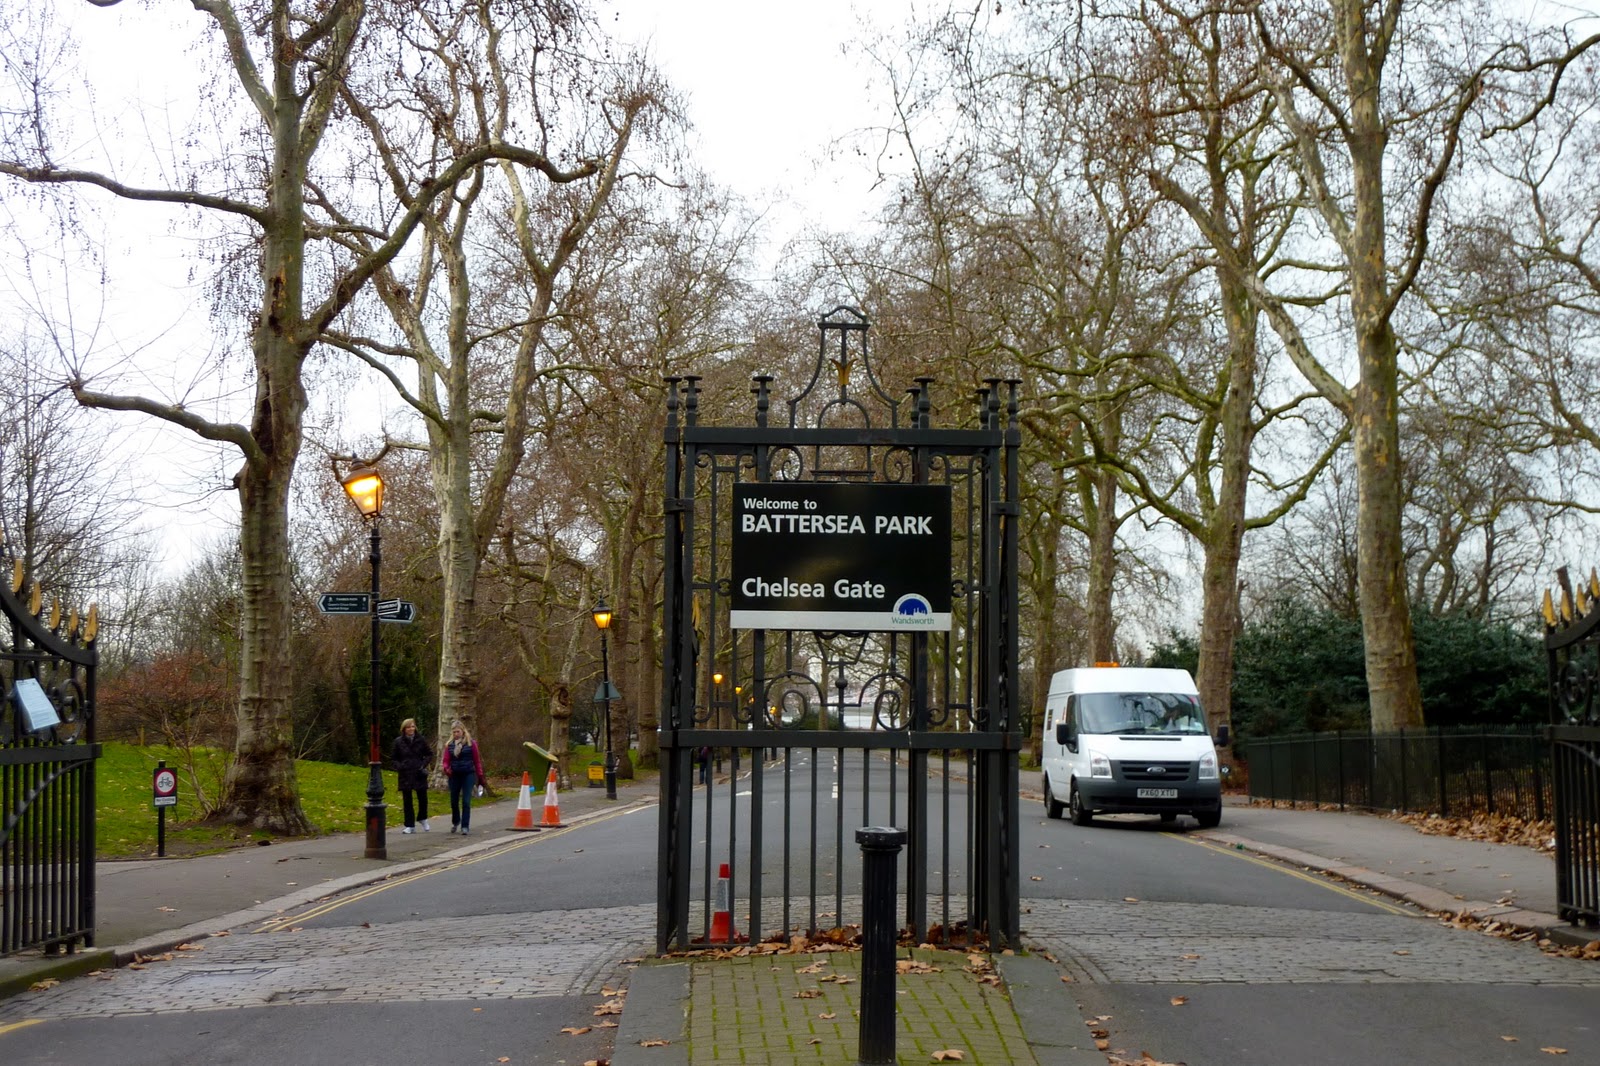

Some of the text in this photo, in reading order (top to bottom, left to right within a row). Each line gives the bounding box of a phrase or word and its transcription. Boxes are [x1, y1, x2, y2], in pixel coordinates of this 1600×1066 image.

[743, 497, 817, 510] Welcome to
[742, 513, 933, 535] BATTERSEA PARK
[741, 577, 886, 599] Chelsea Gate
[891, 616, 935, 625] Wandsworth
